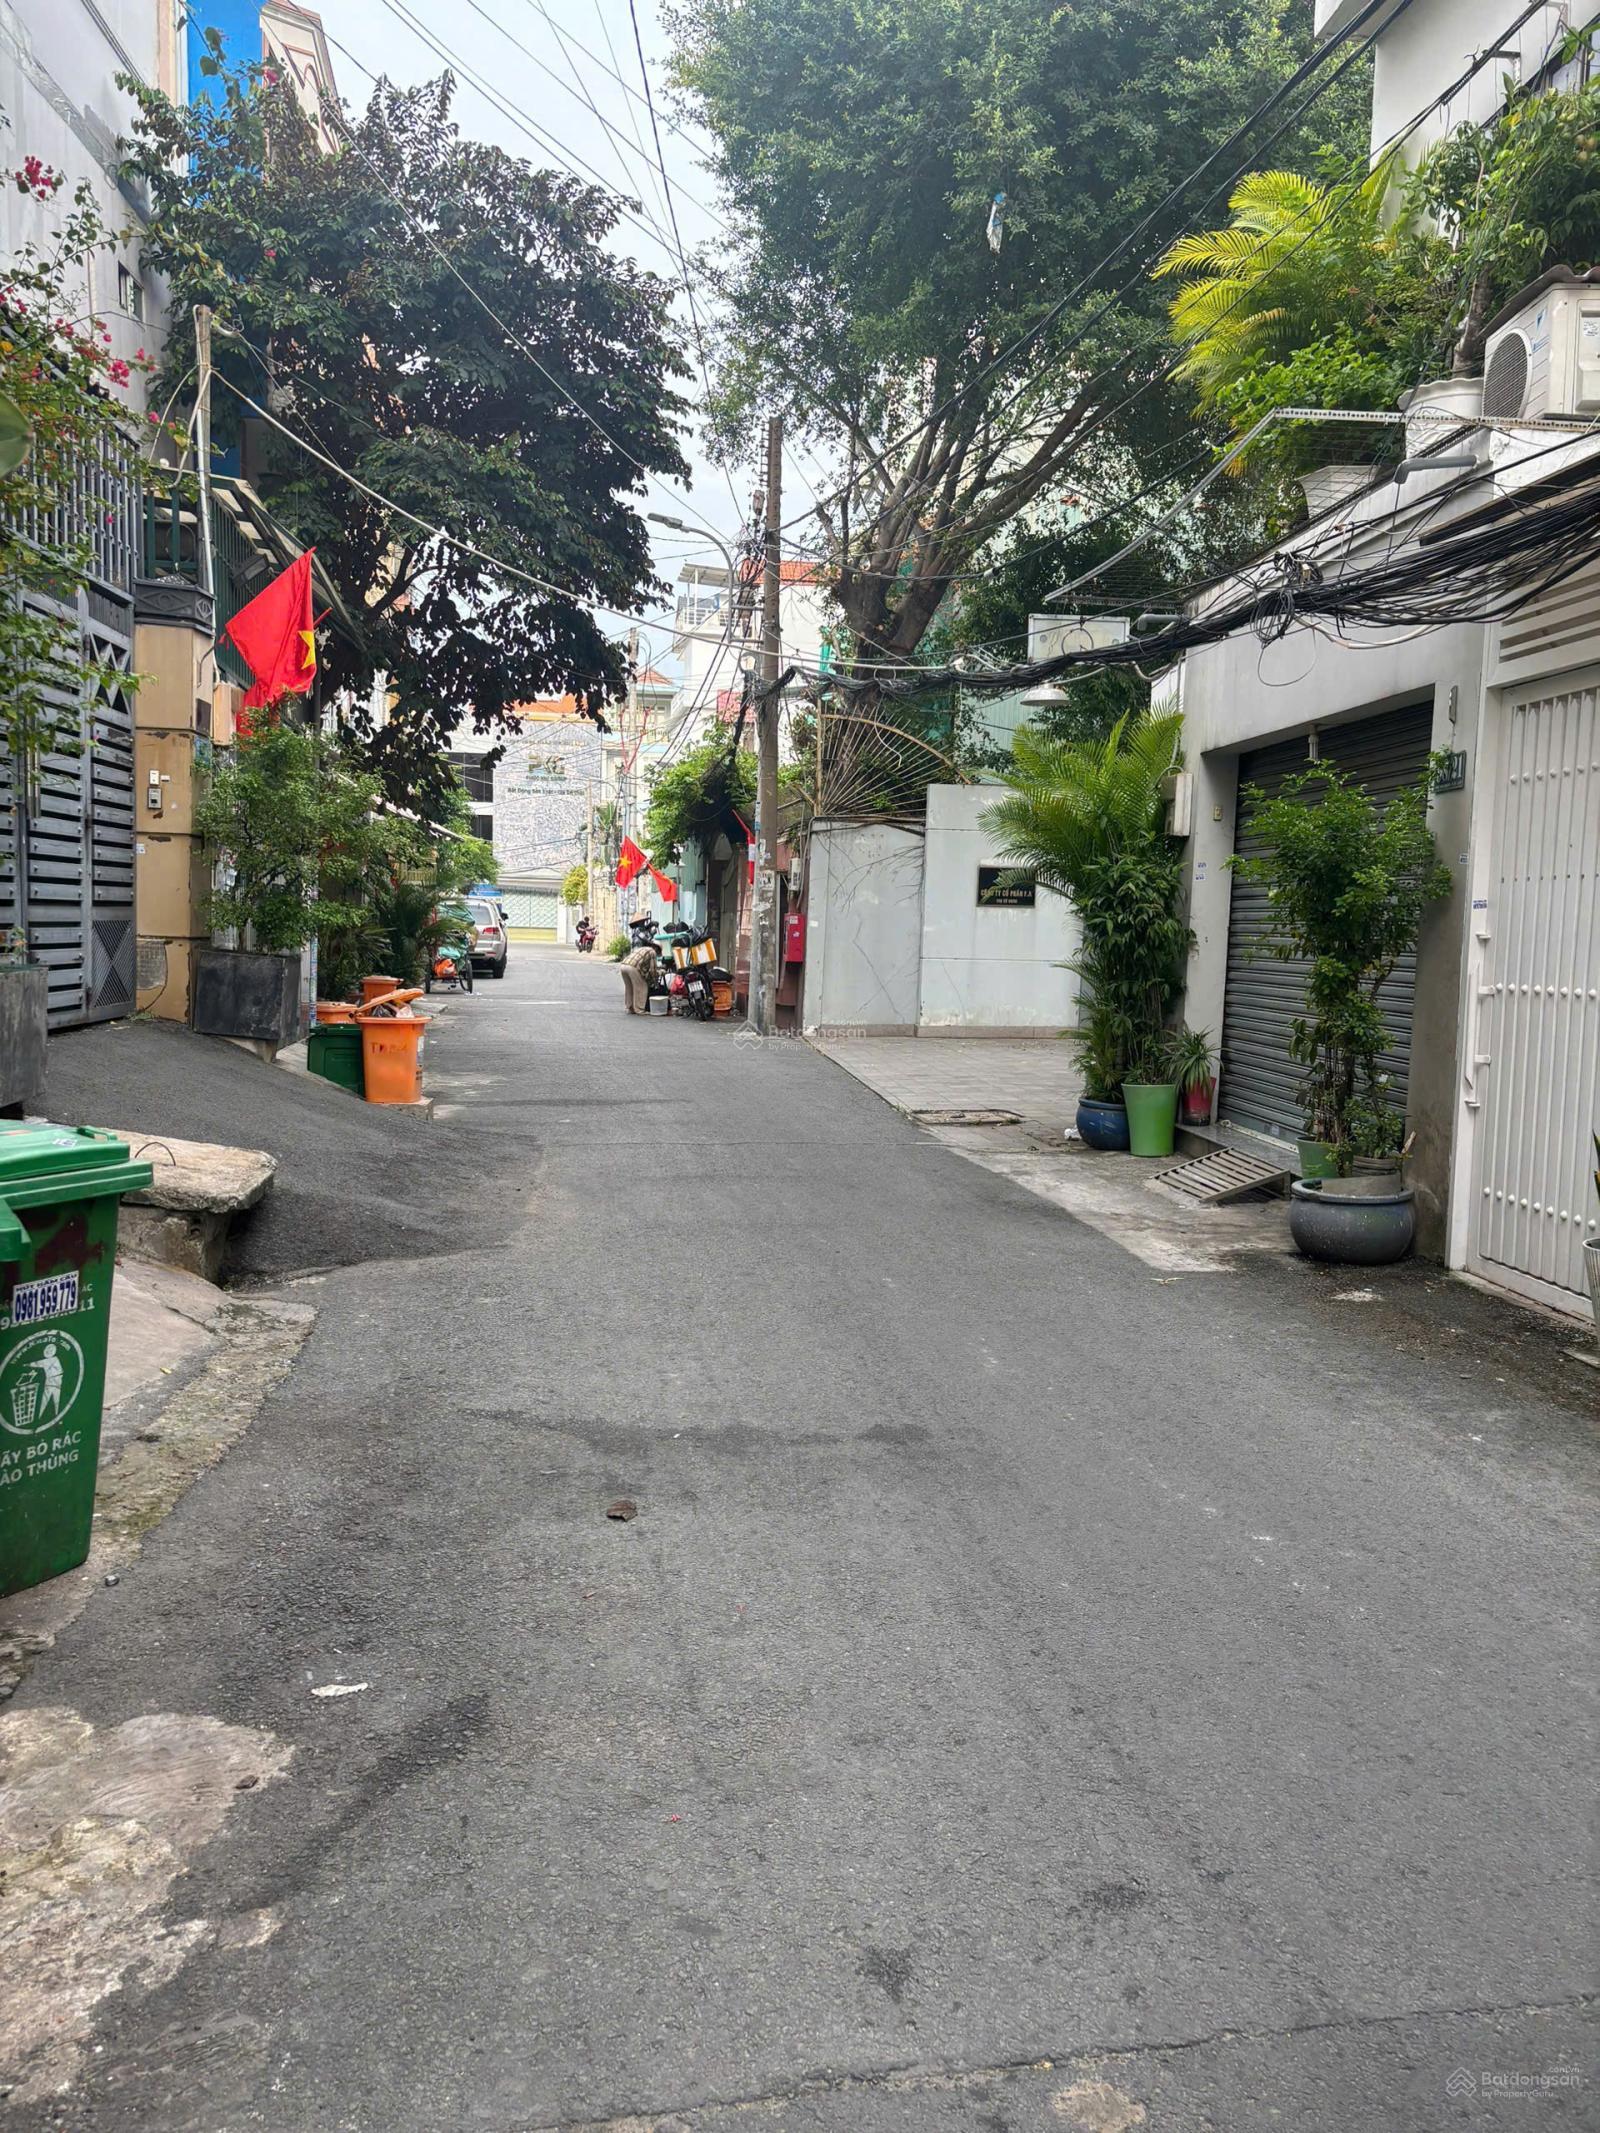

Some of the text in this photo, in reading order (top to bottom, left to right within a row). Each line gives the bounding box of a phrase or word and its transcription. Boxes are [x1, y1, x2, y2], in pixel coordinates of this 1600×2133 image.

[15, 1280, 77, 1322] 0981.959.779
[0, 1430, 81, 1468] ÃY BỎ RÁC
[0, 1449, 79, 1487] ÀO THÙNG
